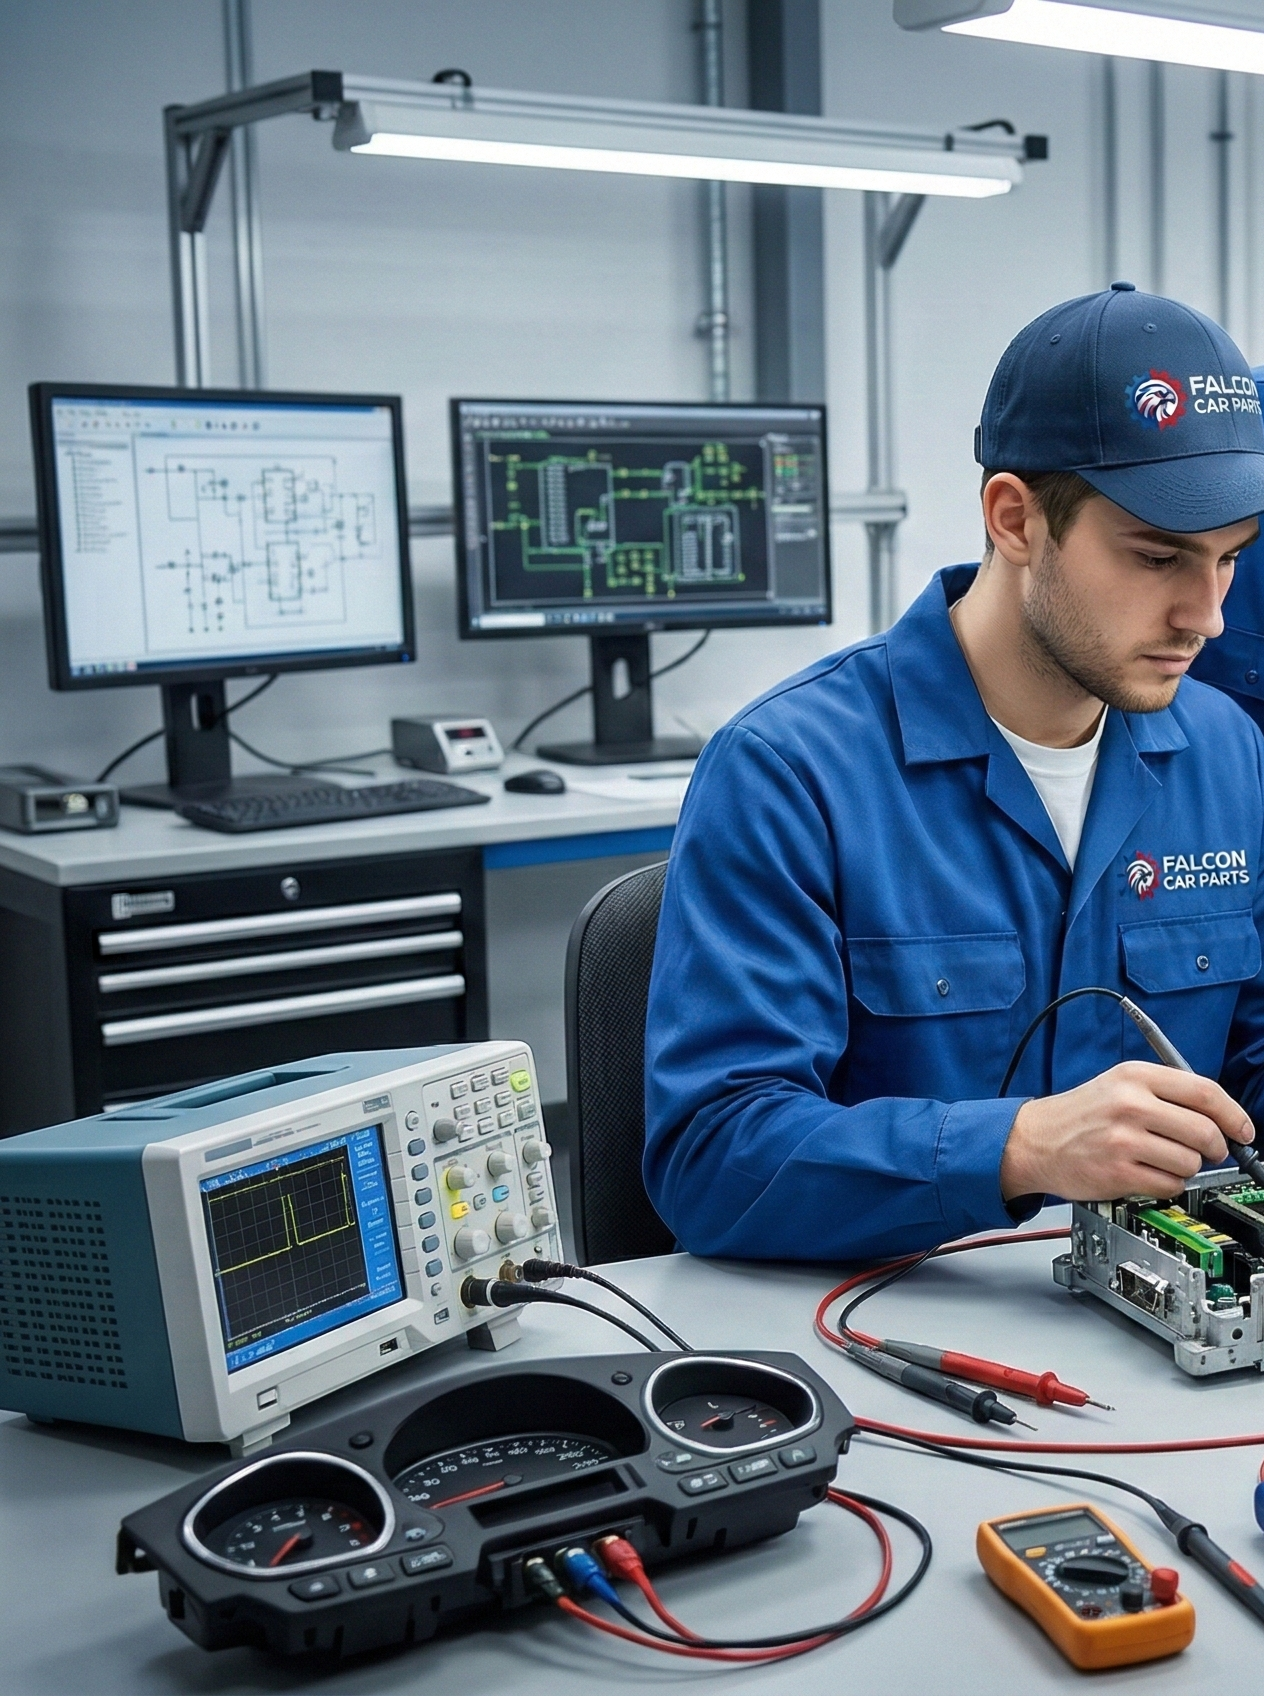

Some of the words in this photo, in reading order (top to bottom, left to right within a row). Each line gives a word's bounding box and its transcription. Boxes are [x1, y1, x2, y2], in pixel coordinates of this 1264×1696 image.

[1188, 375, 1259, 398] FALCON
[1194, 398, 1231, 414] CAR
[1232, 397, 1263, 416] PARTS
[1162, 849, 1247, 874] FALCON
[1163, 874, 1197, 891] CAR
[1199, 869, 1250, 888] PARTS
